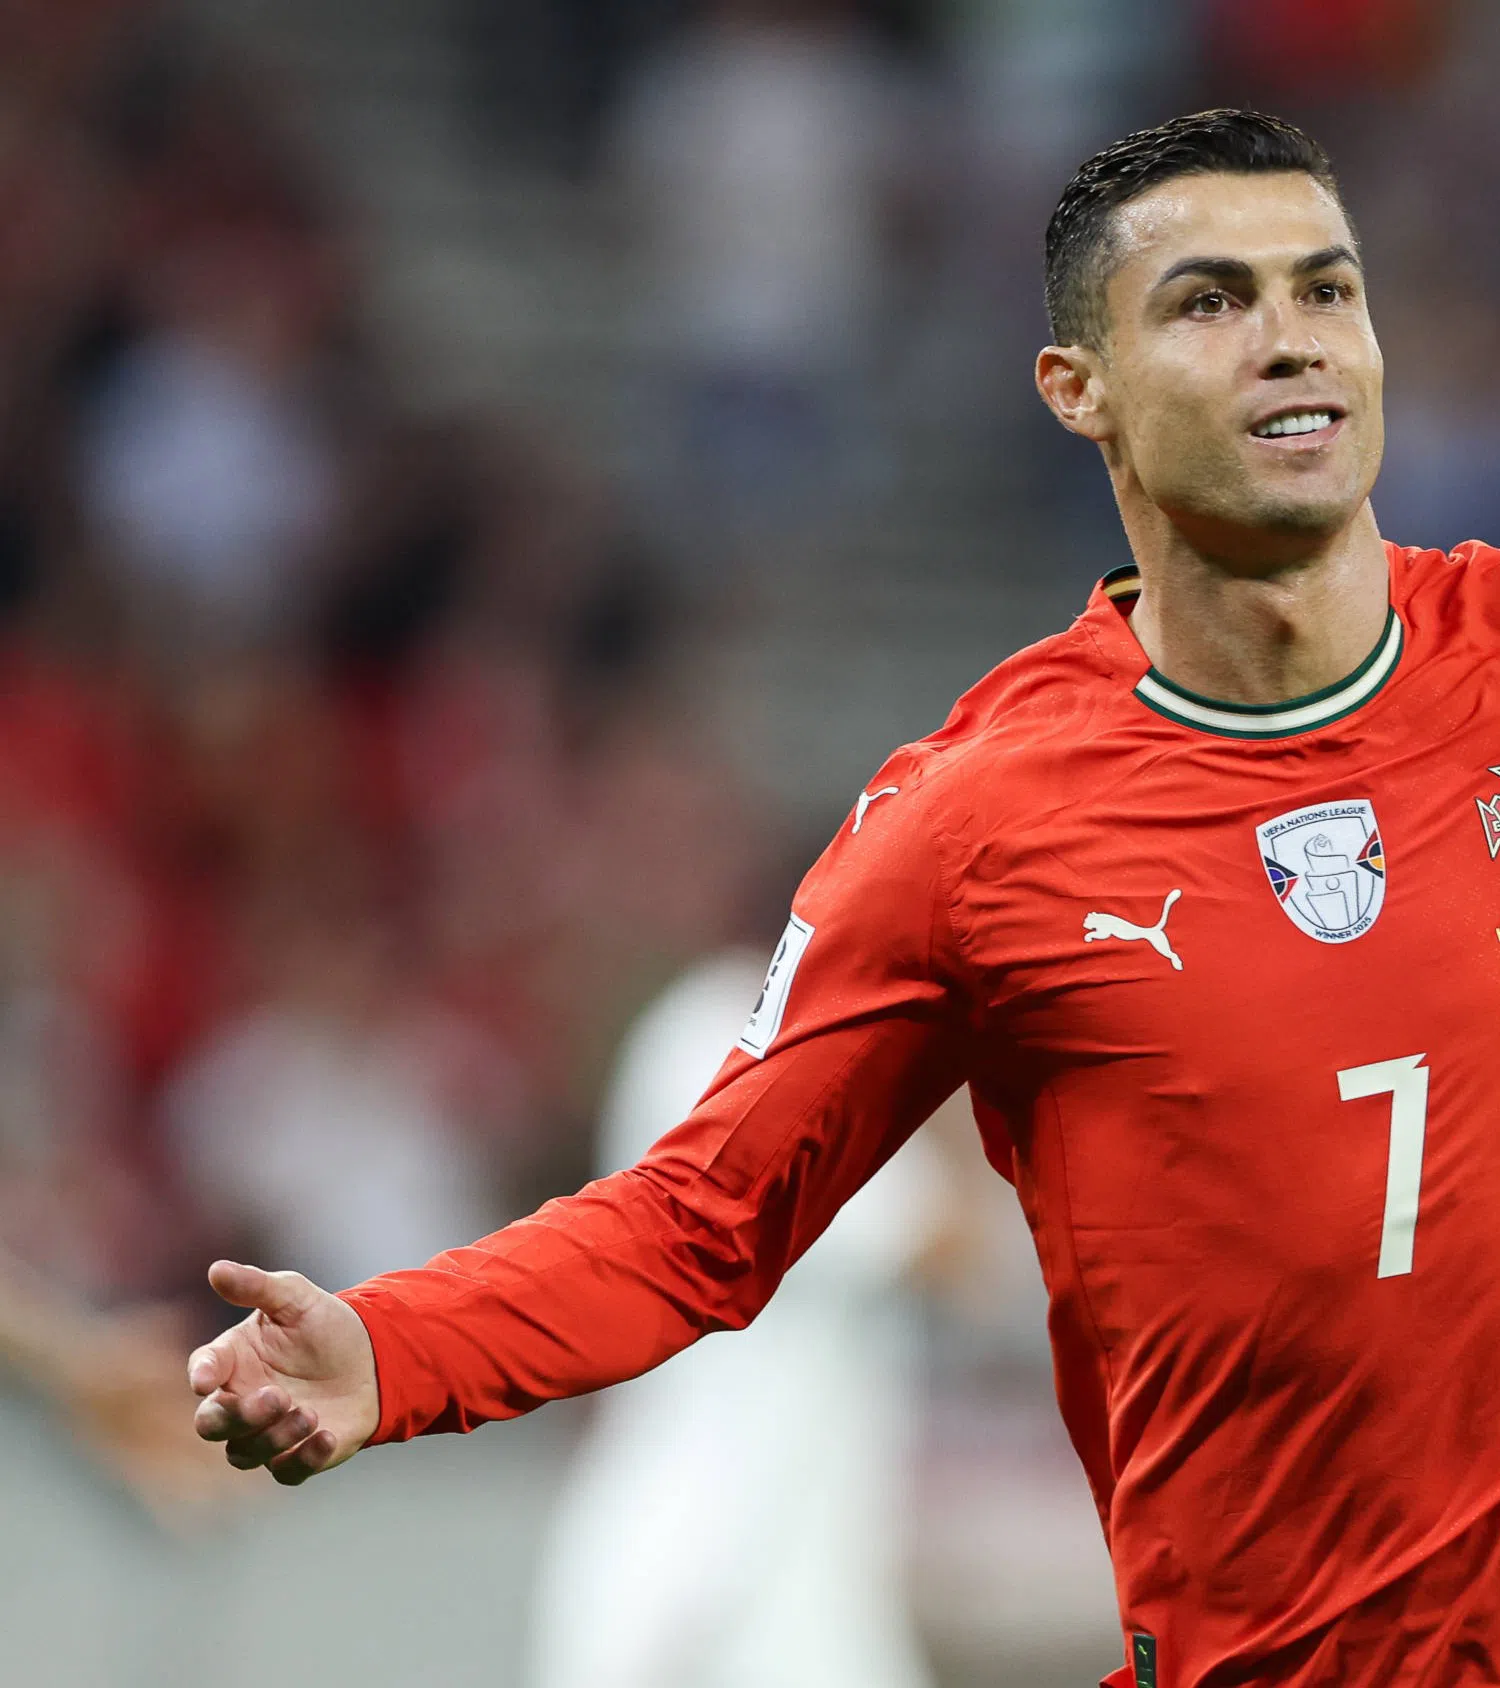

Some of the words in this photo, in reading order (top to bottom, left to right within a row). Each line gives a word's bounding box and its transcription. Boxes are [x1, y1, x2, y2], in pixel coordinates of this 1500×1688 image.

[1263, 824, 1286, 838] UEFA
[1287, 810, 1328, 827] NATIONS
[1329, 806, 1366, 816] LEAGUE
[1315, 929, 1352, 939] WINNER
[1353, 916, 1371, 934] 2025
[1336, 1053, 1429, 1279] 7
